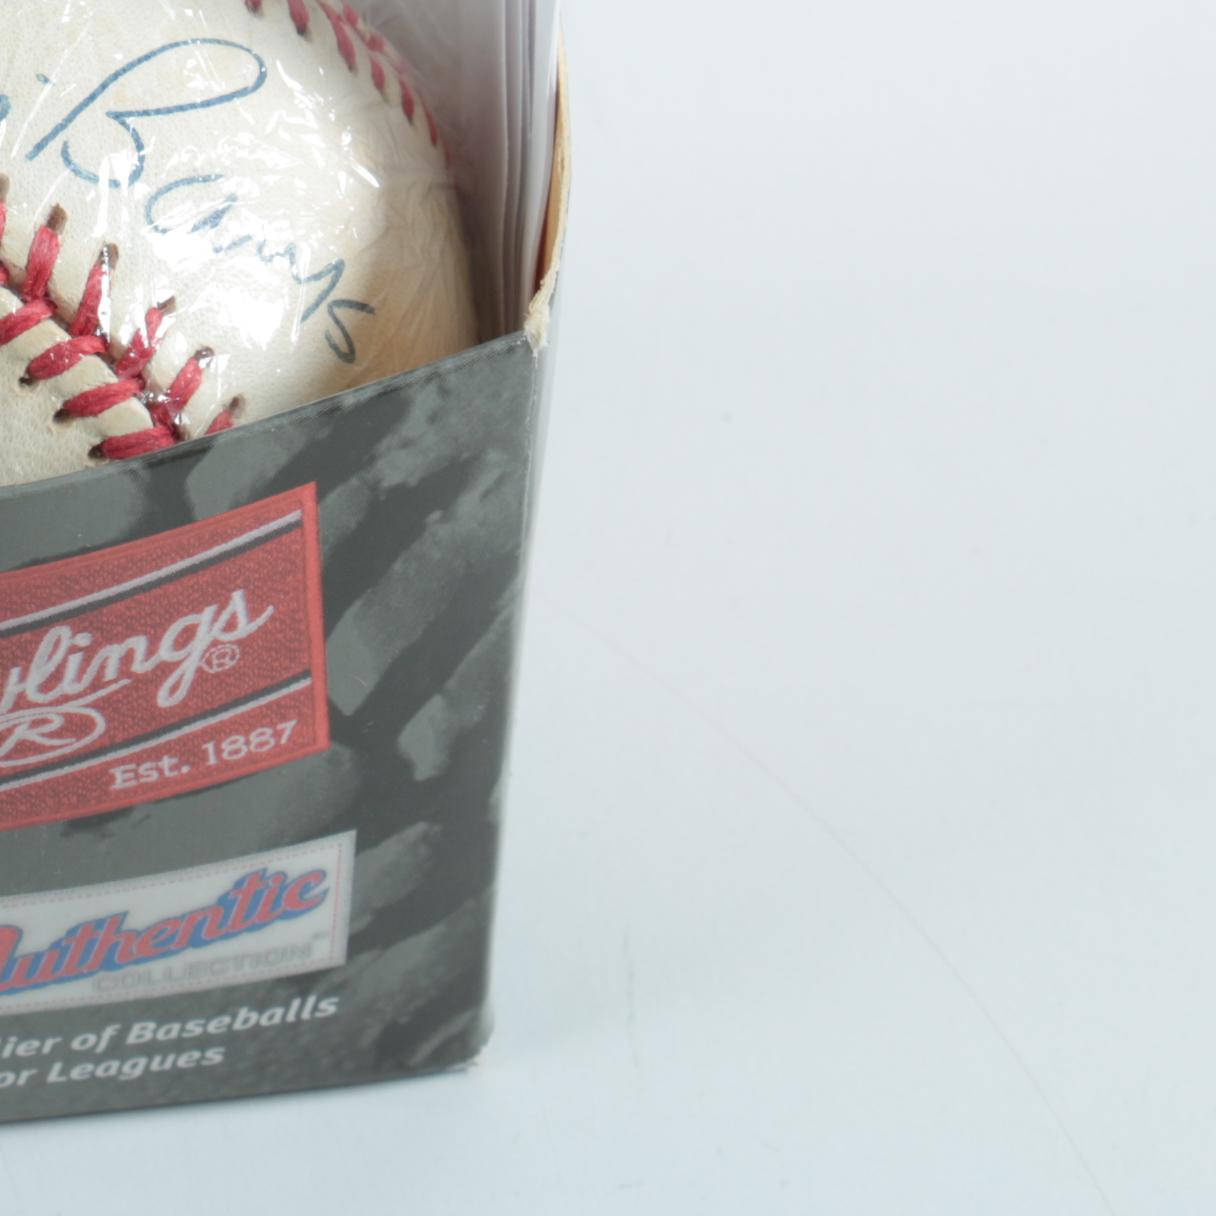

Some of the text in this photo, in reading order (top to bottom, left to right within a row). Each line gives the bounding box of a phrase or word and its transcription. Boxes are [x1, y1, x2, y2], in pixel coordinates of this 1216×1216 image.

[110, 718, 299, 791] Est. 1887
[70, 1023, 123, 1054] of
[125, 994, 341, 1046] Baseballs
[46, 1045, 227, 1084] Leagues
